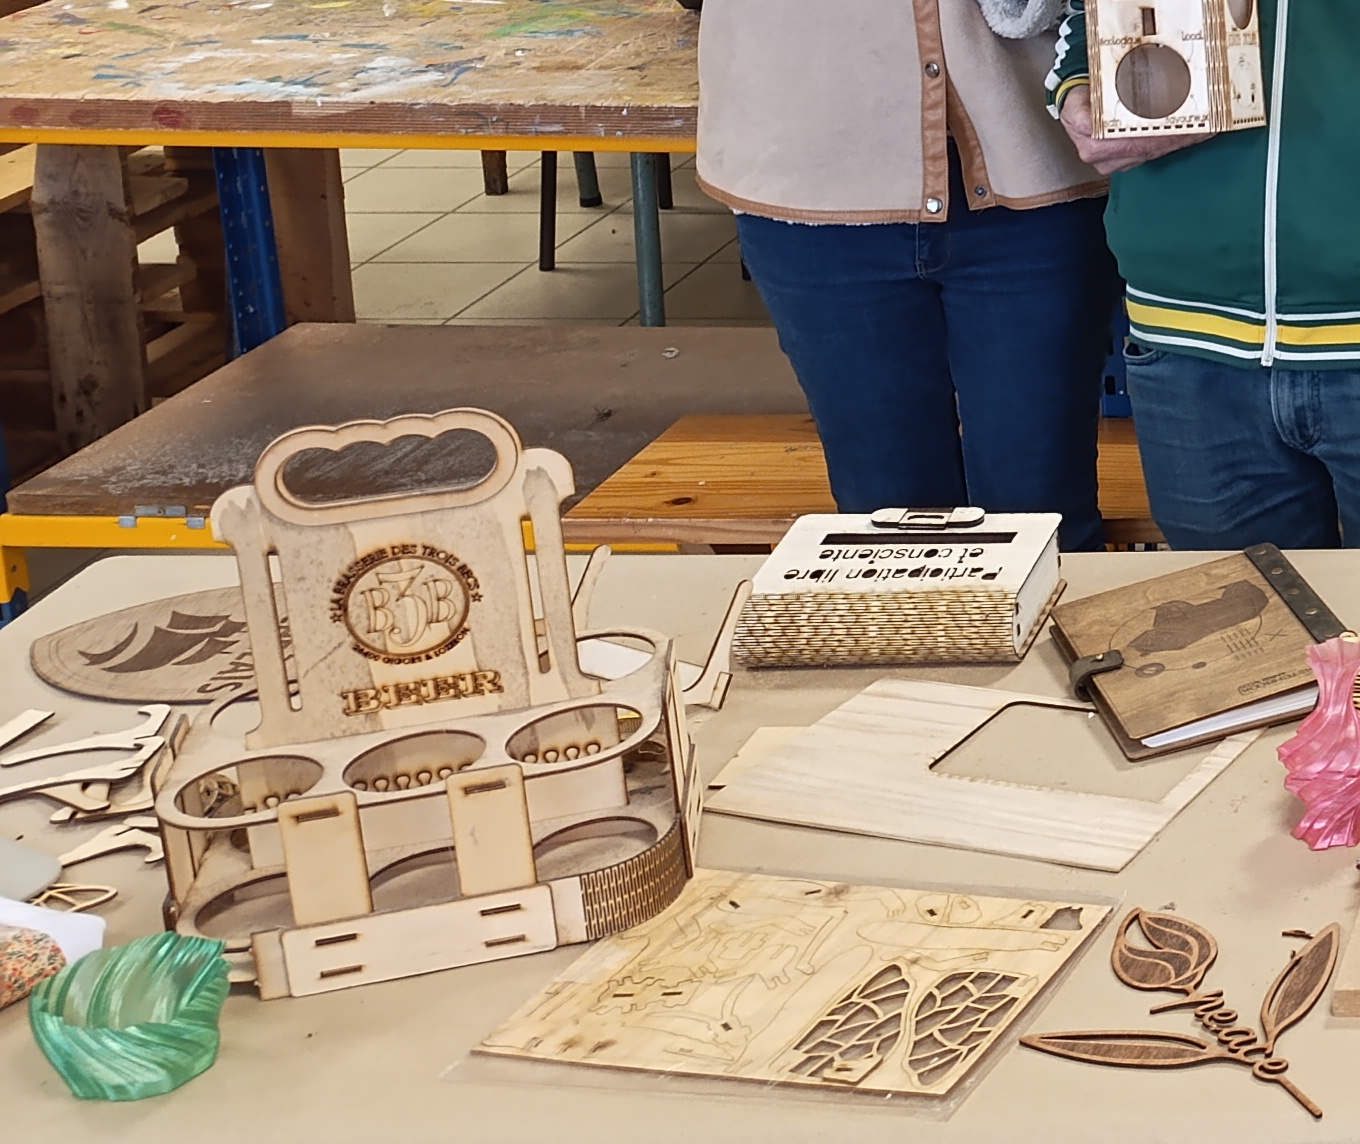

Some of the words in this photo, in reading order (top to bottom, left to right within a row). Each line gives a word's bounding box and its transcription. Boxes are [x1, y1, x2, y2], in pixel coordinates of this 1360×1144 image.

[392, 543, 418, 556] DES
[421, 544, 460, 567] TROIS
[818, 547, 953, 565] consciente
[957, 547, 985, 564] et
[332, 547, 389, 596] BRASSERIE
[456, 563, 481, 592] BECS
[783, 567, 839, 584] libre
[845, 565, 1003, 583] Participation
[330, 595, 343, 612] LA
[351, 643, 381, 662] 26400
[340, 669, 504, 717] BEER
